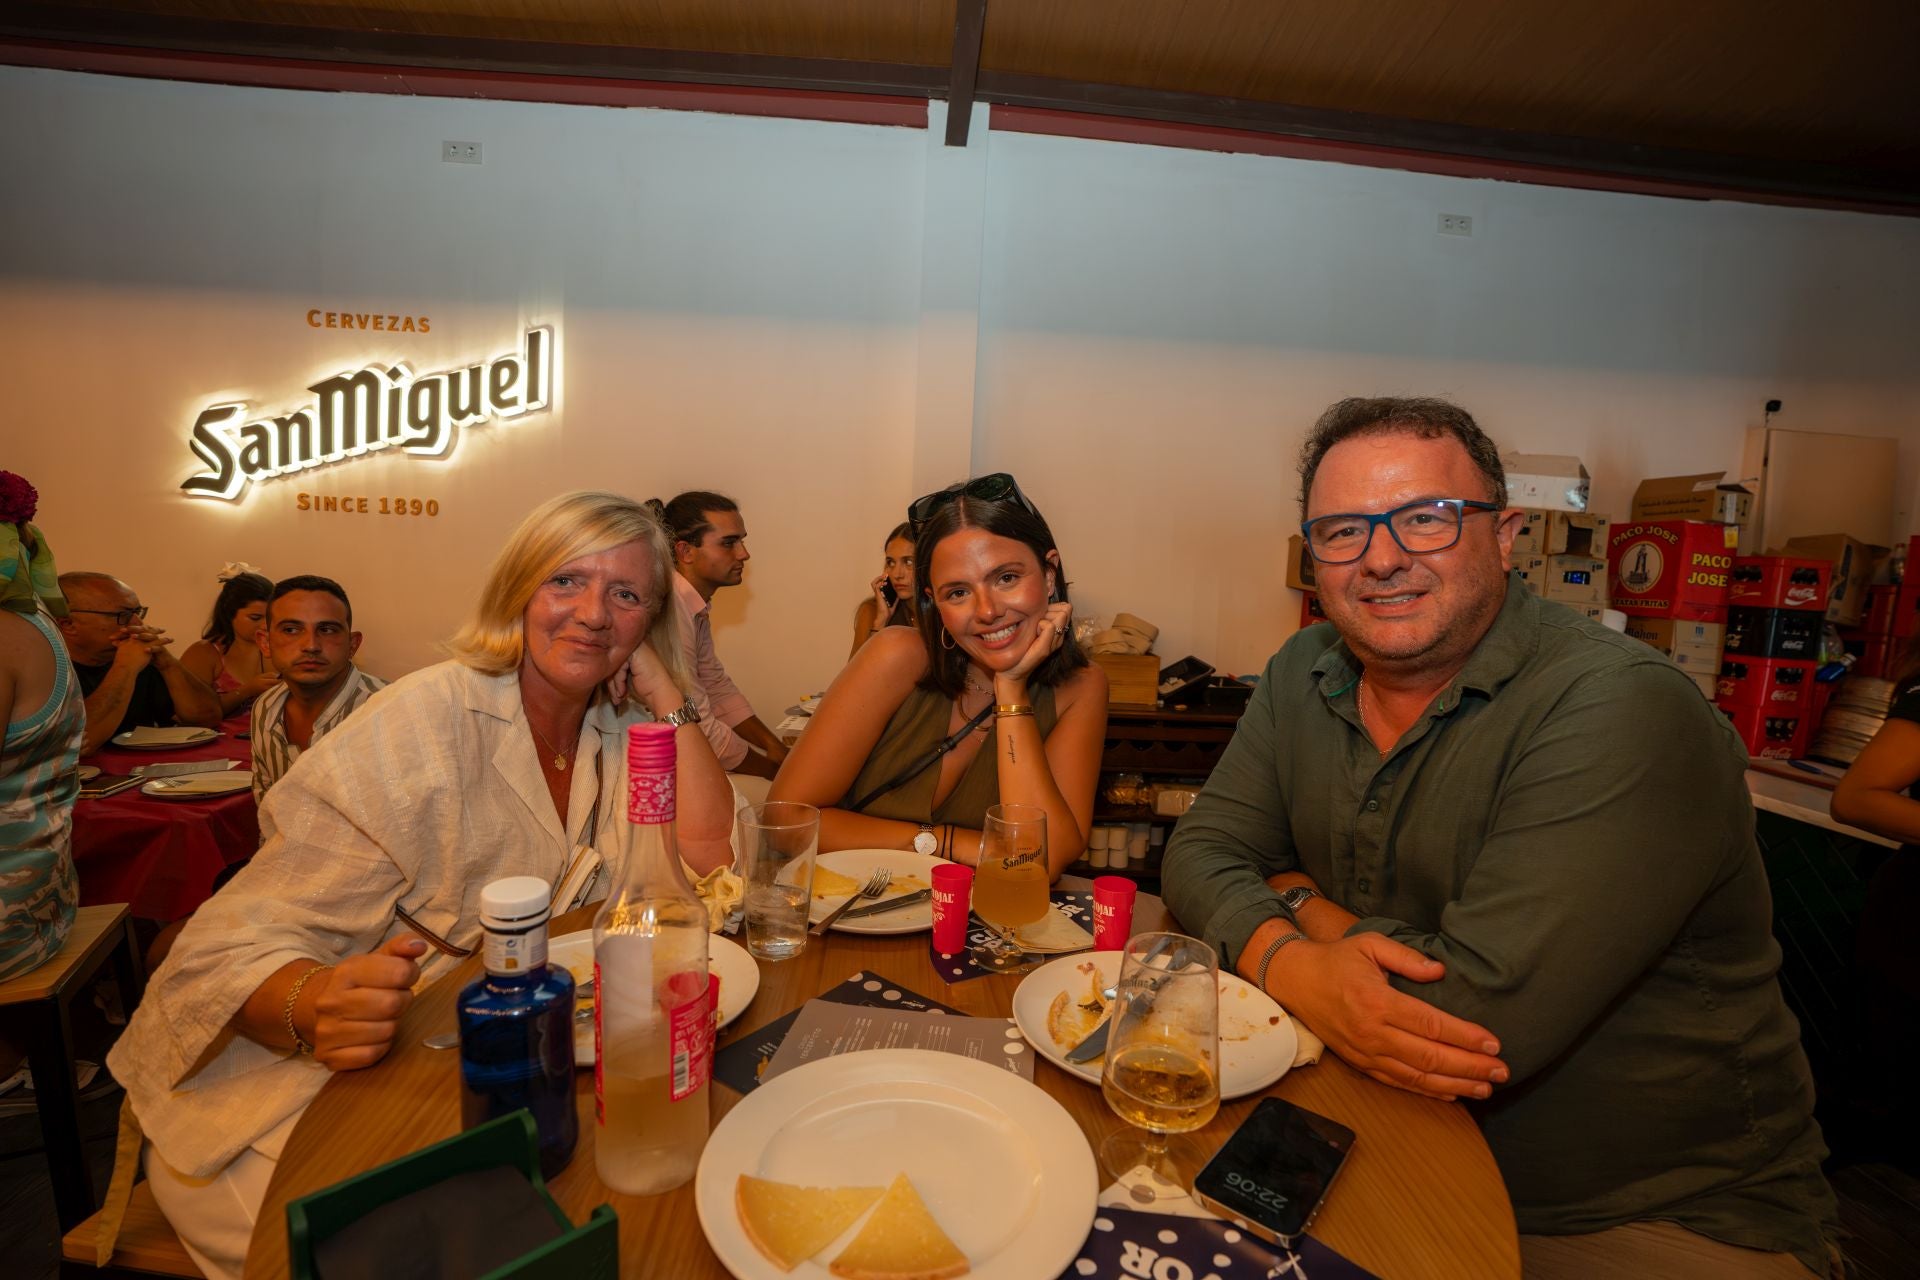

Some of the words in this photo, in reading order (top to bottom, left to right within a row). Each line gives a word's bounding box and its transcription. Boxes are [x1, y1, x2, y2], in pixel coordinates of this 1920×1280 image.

[306, 308, 431, 333] CERVEZAS
[296, 492, 369, 514] SINCE
[379, 495, 439, 517] 1890
[1612, 526, 1644, 547] PACO
[1646, 525, 1679, 545] JOSE
[1691, 552, 1732, 569] PACO
[1687, 571, 1729, 587] JOSE
[1225, 1171, 1289, 1209] 22:06
